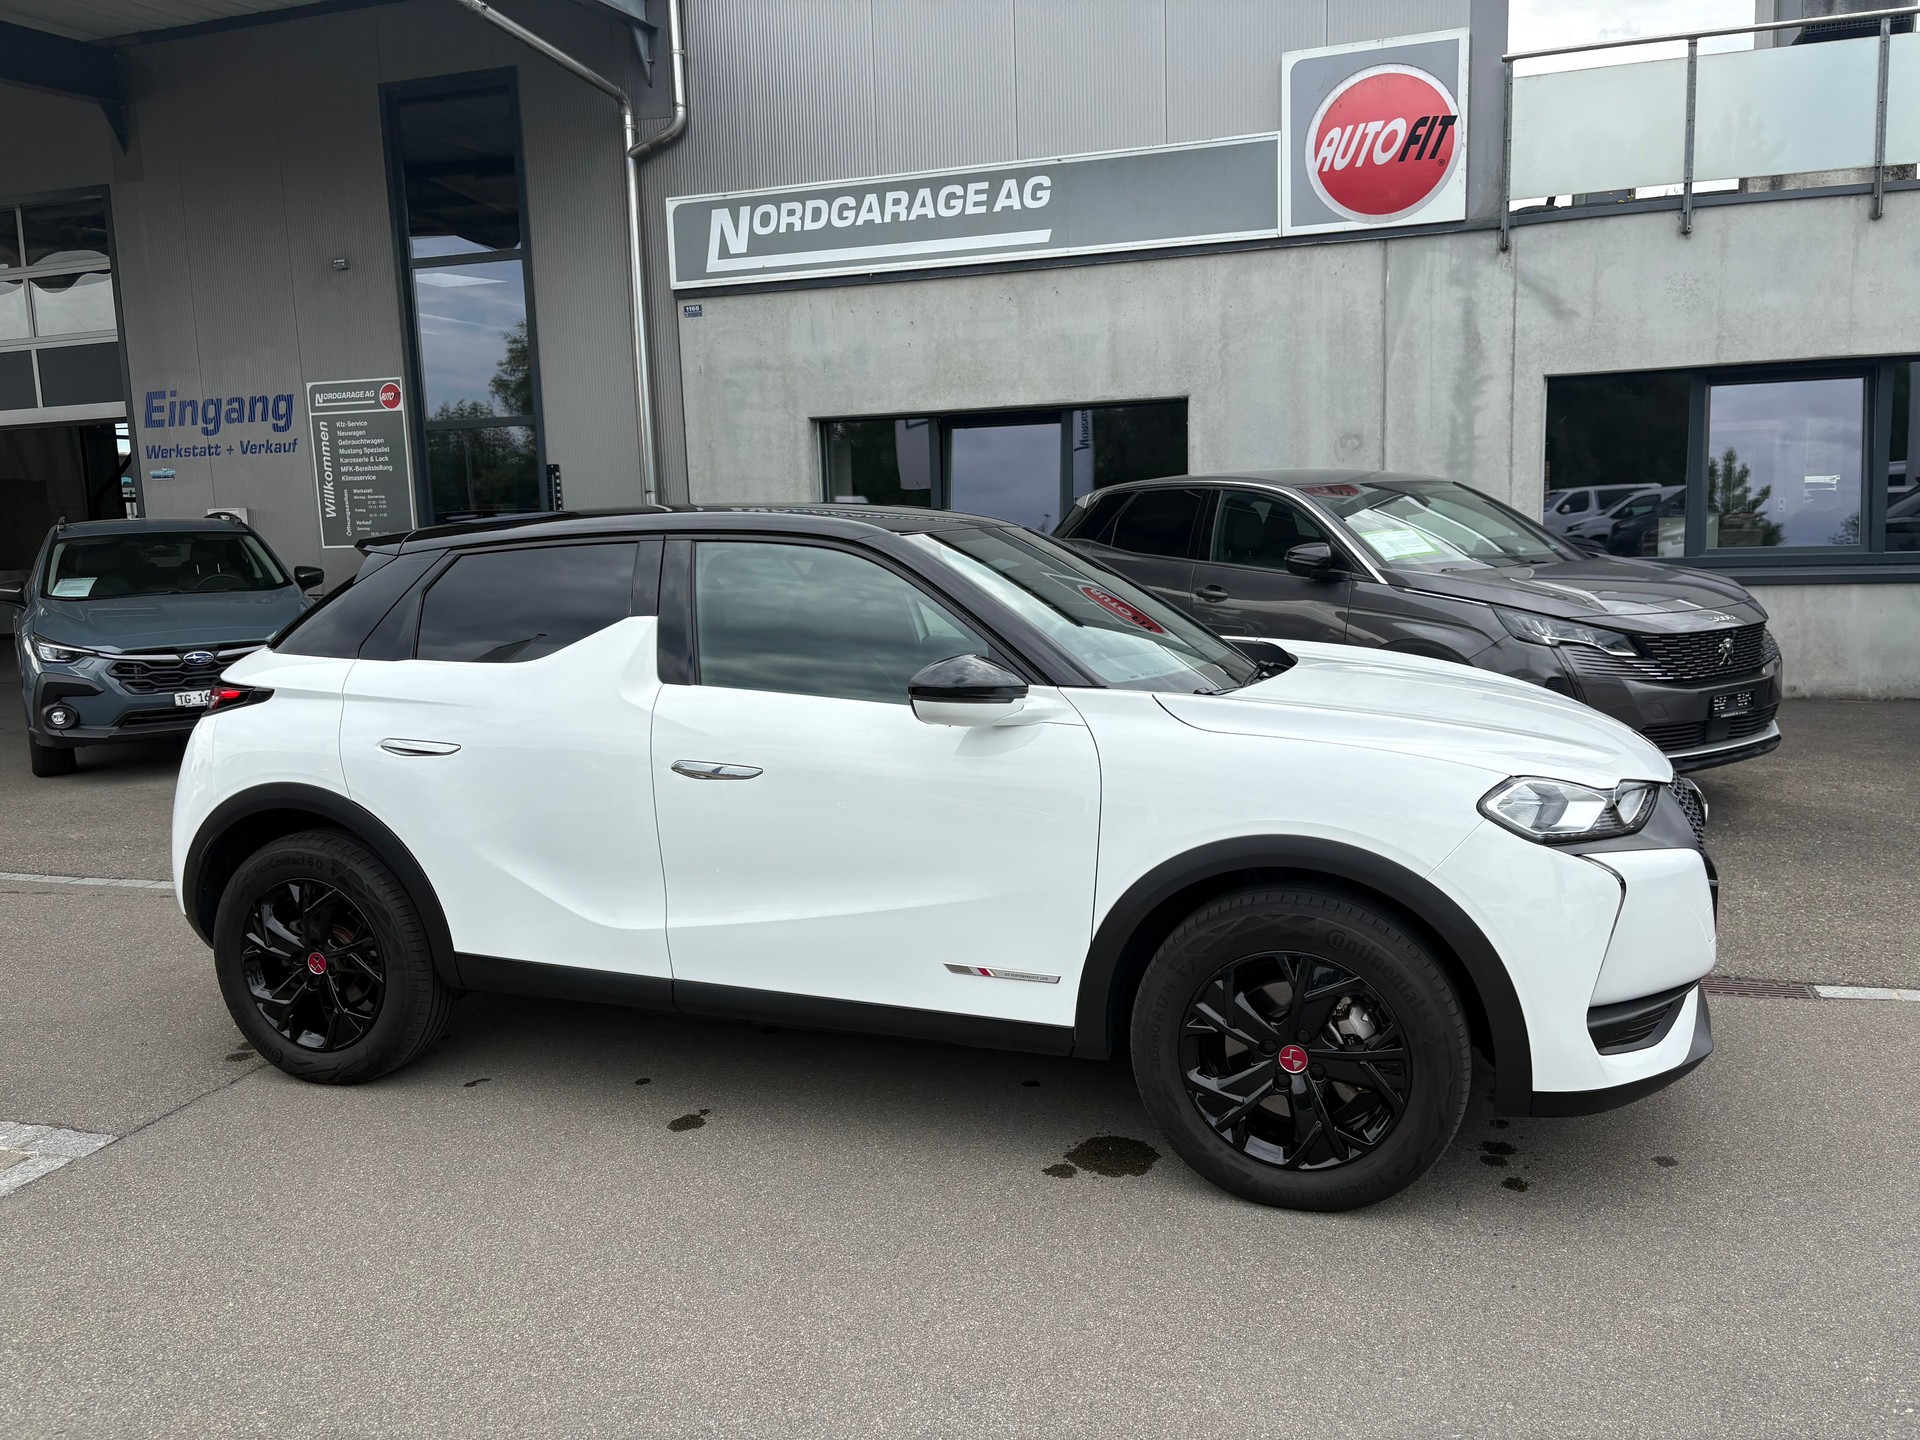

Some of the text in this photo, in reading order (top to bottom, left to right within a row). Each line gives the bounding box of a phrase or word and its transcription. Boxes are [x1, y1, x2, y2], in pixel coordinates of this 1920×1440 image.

[1315, 115, 1458, 173] AUTOFIT
[706, 175, 1052, 272] NORDGARAGE AG
[315, 390, 375, 406] NORDGARAGE AG
[144, 390, 294, 436] Eingang
[336, 420, 368, 428] Kfz-Service
[145, 438, 299, 460] Werkstatt + Verkauf
[338, 438, 385, 446] Gebrauchtwagen
[363, 446, 390, 454] Spezialist
[340, 456, 369, 464] Karosserie
[319, 421, 337, 518] Willkommen
[177, 694, 191, 704] TG
